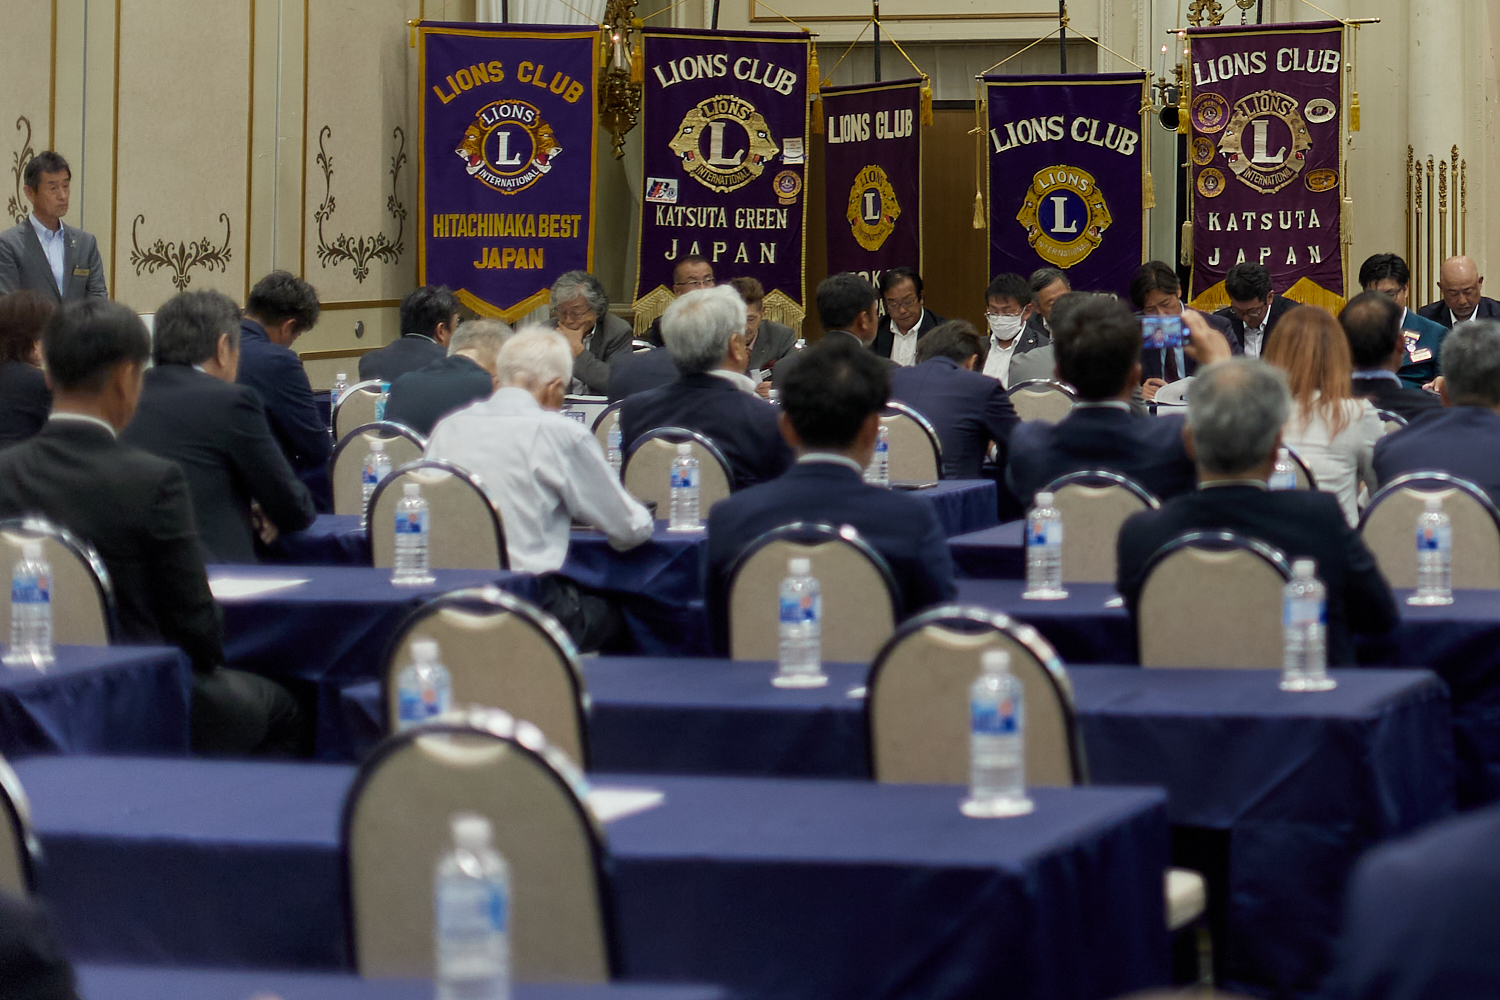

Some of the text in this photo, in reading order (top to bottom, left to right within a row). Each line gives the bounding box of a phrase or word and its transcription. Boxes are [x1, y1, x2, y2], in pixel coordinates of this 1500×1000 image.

[653, 53, 798, 97] LIONS CLUB
[1193, 47, 1341, 87] LIONS CLUB
[432, 60, 585, 105] LIONS CLUB
[481, 104, 535, 125] LIONS
[702, 100, 751, 121] LIONS
[1241, 94, 1292, 118] LIONS
[828, 108, 913, 144] LIONS CLUB
[990, 114, 1140, 156] LIONS CLUB
[495, 131, 521, 165] L
[708, 121, 745, 165] L
[1251, 119, 1287, 164] L
[478, 168, 540, 188] INTERNATIONAL
[694, 165, 751, 186] INTERNATIONAL
[860, 170, 884, 188] LIONS
[1038, 170, 1089, 192] LIONS
[1242, 168, 1293, 186] INTERNATIONAL
[655, 205, 788, 229] KATSUTA GREEN
[863, 192, 880, 221] L
[1050, 196, 1078, 234] L
[433, 213, 582, 238] HITACHINAKA BEST
[1208, 208, 1321, 232] KATSUTA
[473, 247, 544, 269] JAPAN
[664, 238, 777, 265] JAPAN
[1036, 239, 1090, 257] INTERNATIONAL
[1208, 245, 1321, 266] JAPAN
